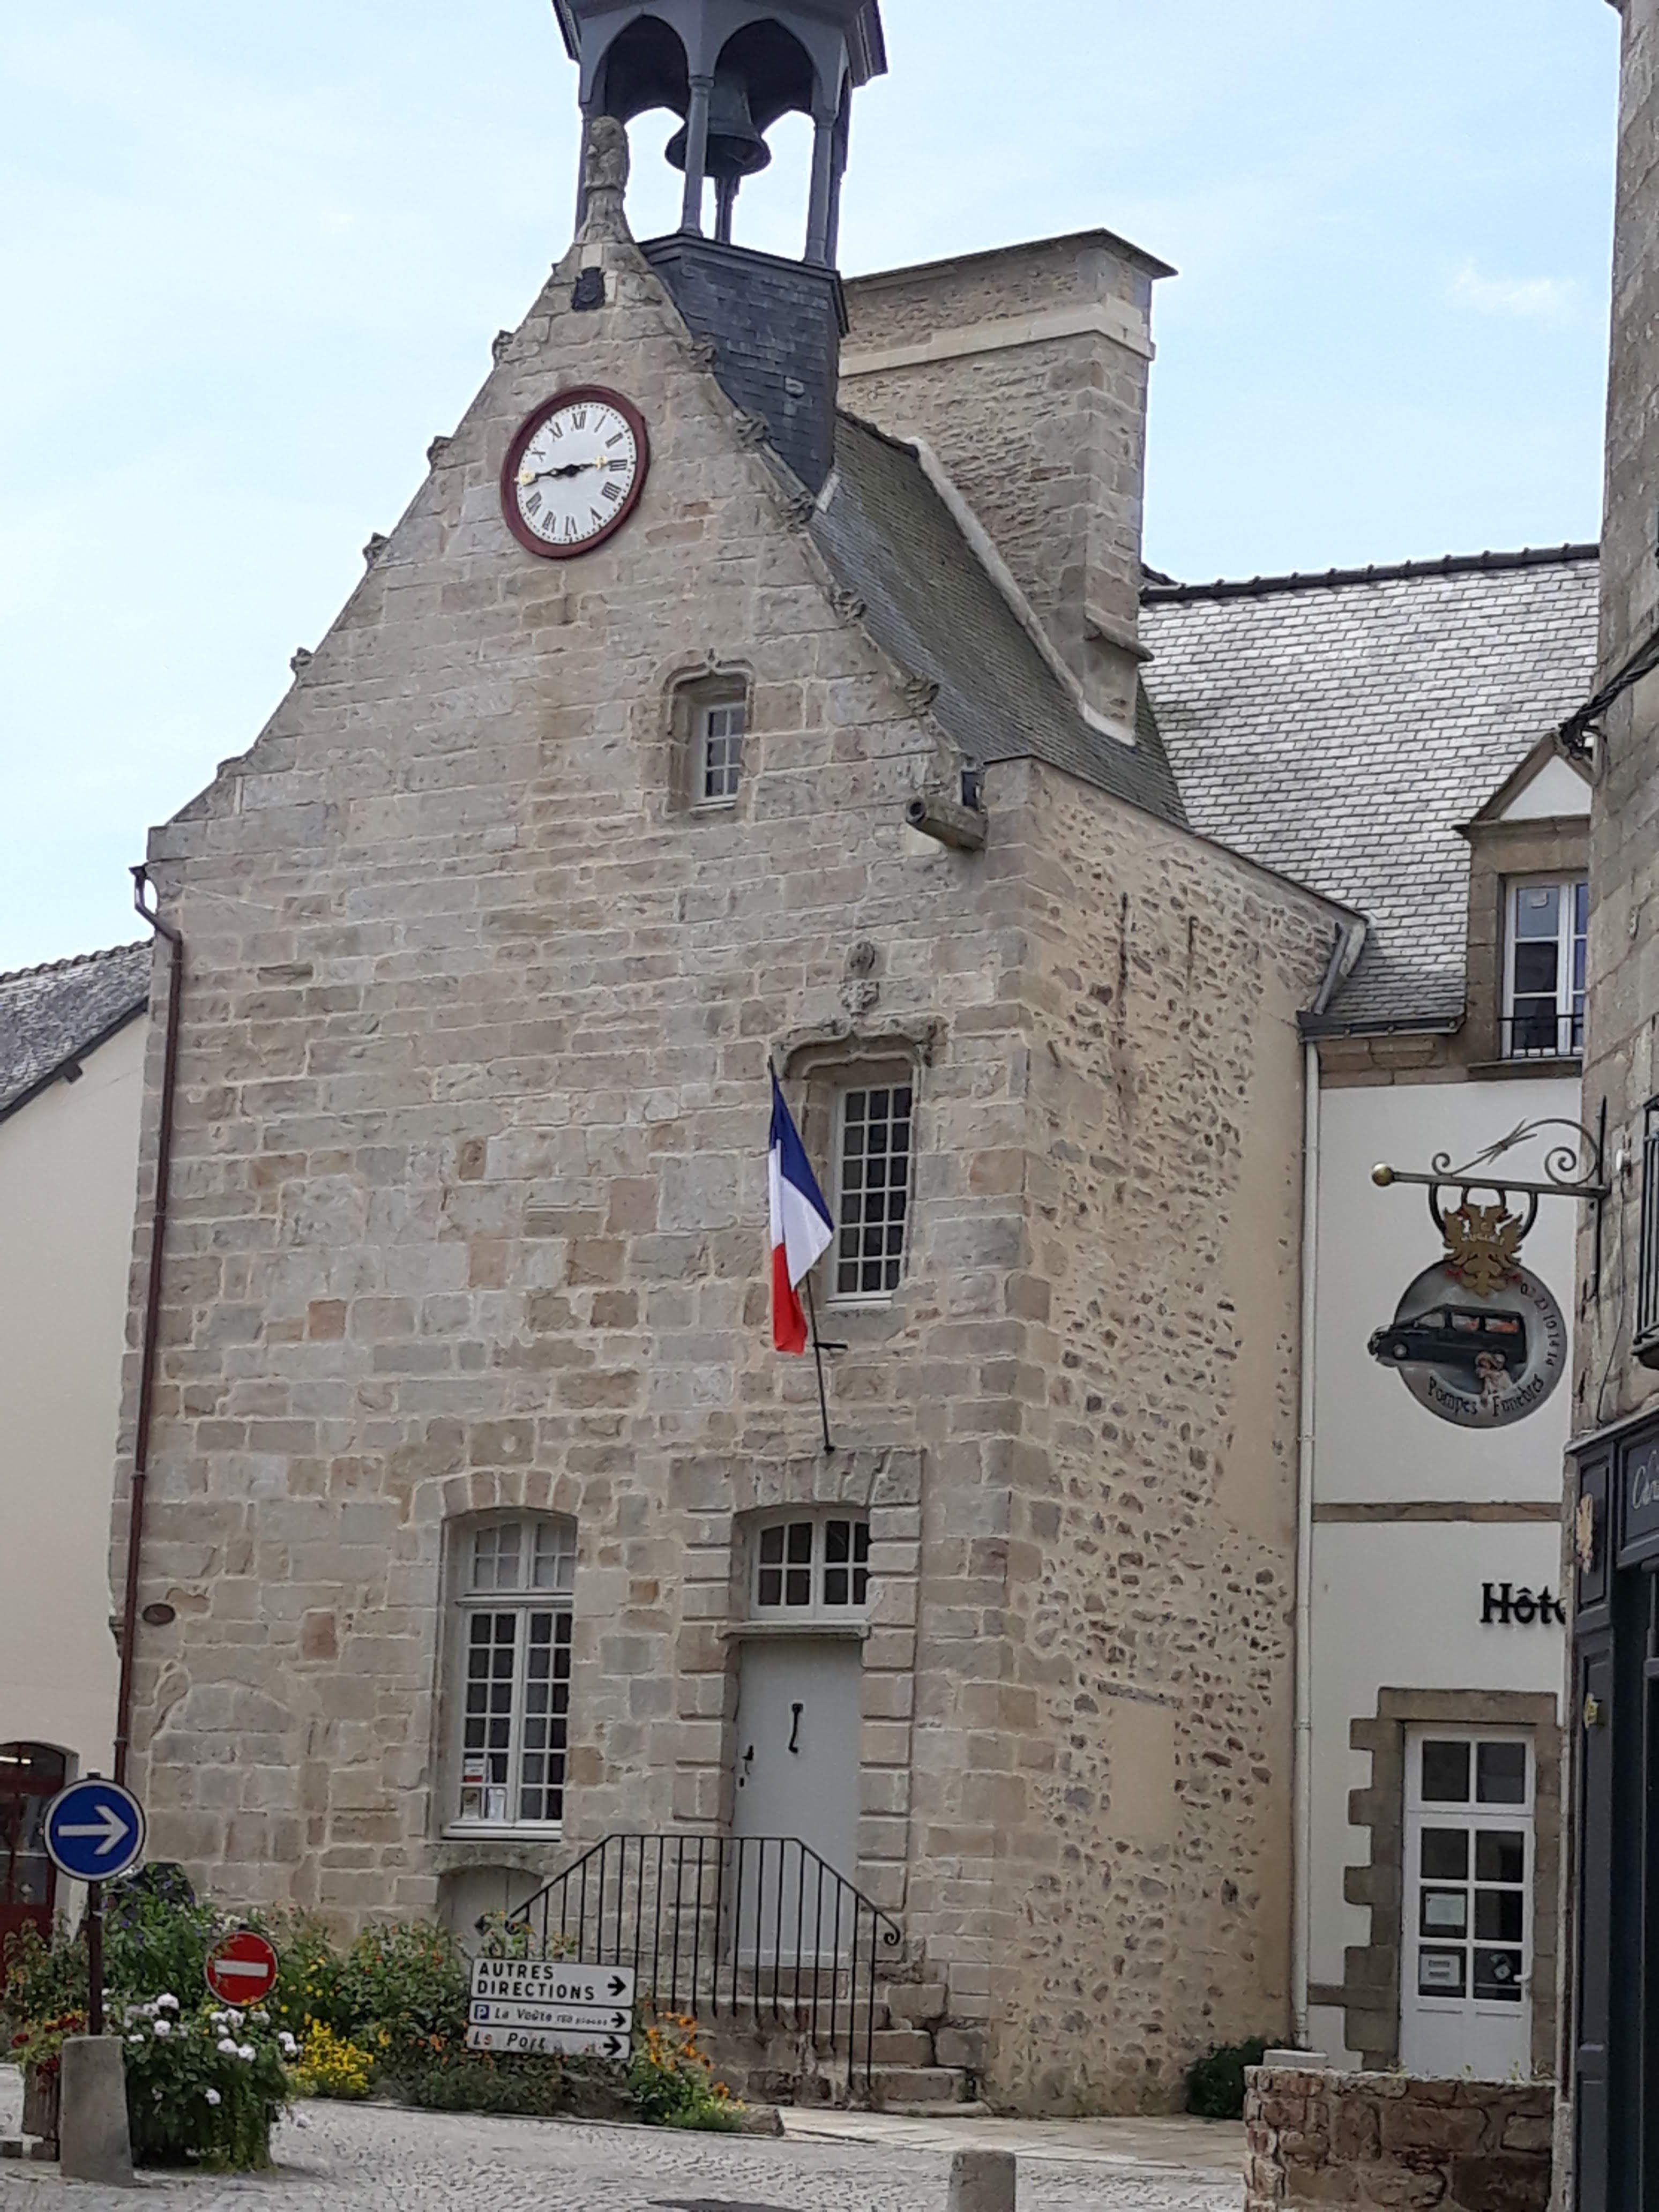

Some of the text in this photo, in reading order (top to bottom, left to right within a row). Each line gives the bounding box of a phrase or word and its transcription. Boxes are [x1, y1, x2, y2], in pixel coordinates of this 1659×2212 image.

[1428, 1376, 1477, 1416] Pompes
[479, 1962, 554, 1980] AUTRES
[477, 1980, 595, 2000] DIRECTIONS
[473, 2030, 546, 2051] Le Port
